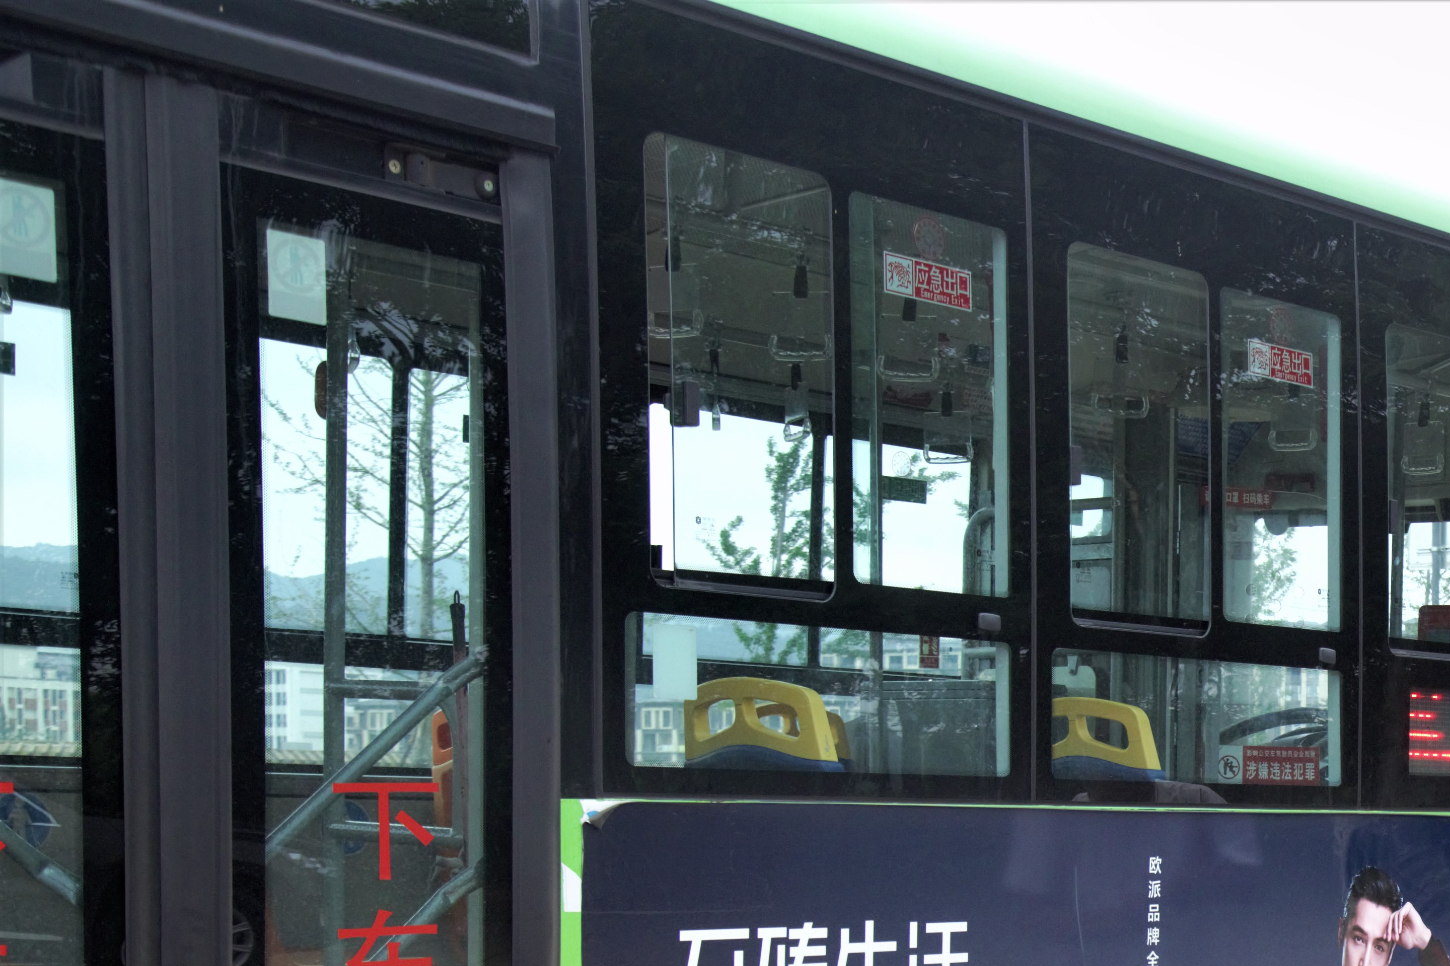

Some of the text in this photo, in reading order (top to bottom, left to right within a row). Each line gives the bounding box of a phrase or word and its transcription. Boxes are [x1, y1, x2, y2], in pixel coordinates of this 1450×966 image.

[915, 262, 971, 298] 应急出口
[920, 289, 966, 307] Emergency Exit
[1271, 347, 1312, 376] 应急出口
[1246, 761, 1316, 781] 涉嫌违法犯罪
